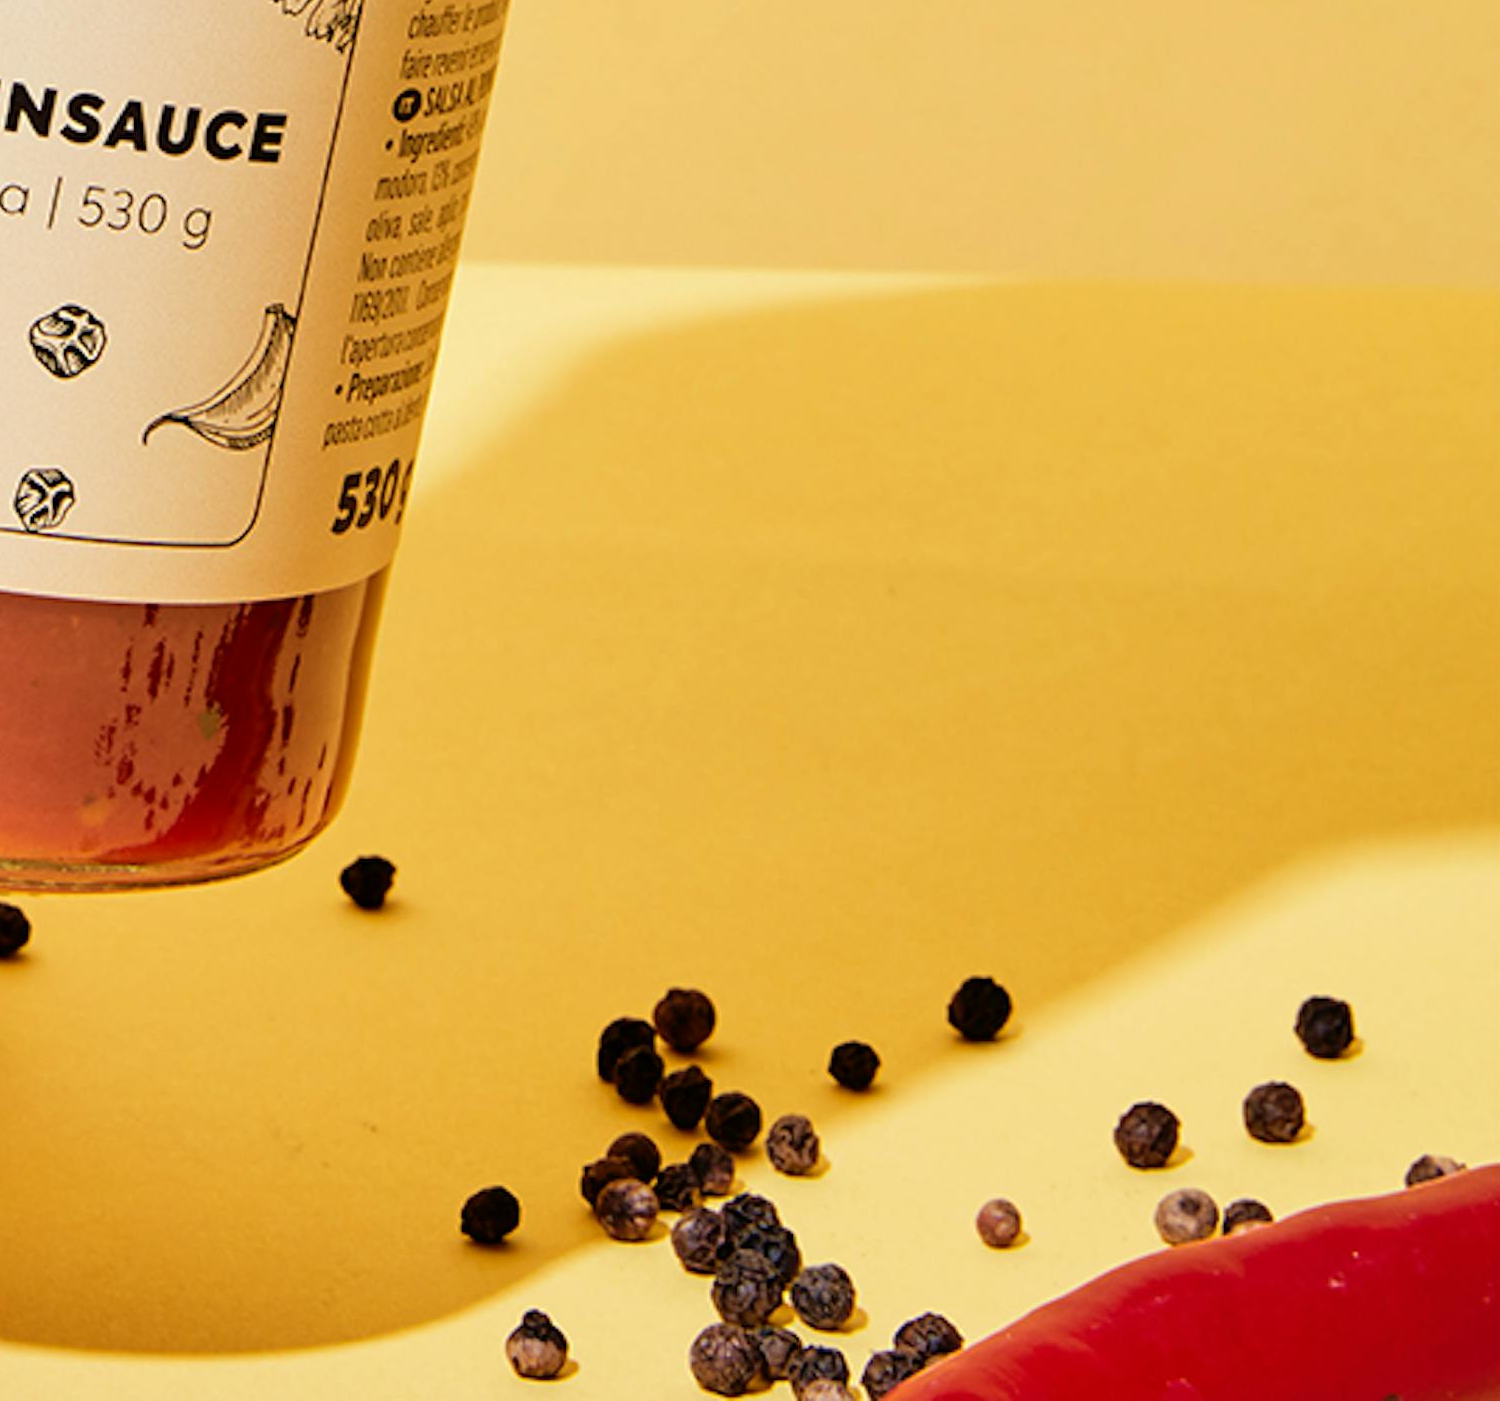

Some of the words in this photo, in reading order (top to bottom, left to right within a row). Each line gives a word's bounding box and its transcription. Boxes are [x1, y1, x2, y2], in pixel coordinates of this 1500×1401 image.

[77, 184, 168, 234] 530
[182, 206, 213, 251] g
[331, 458, 400, 535] 530
